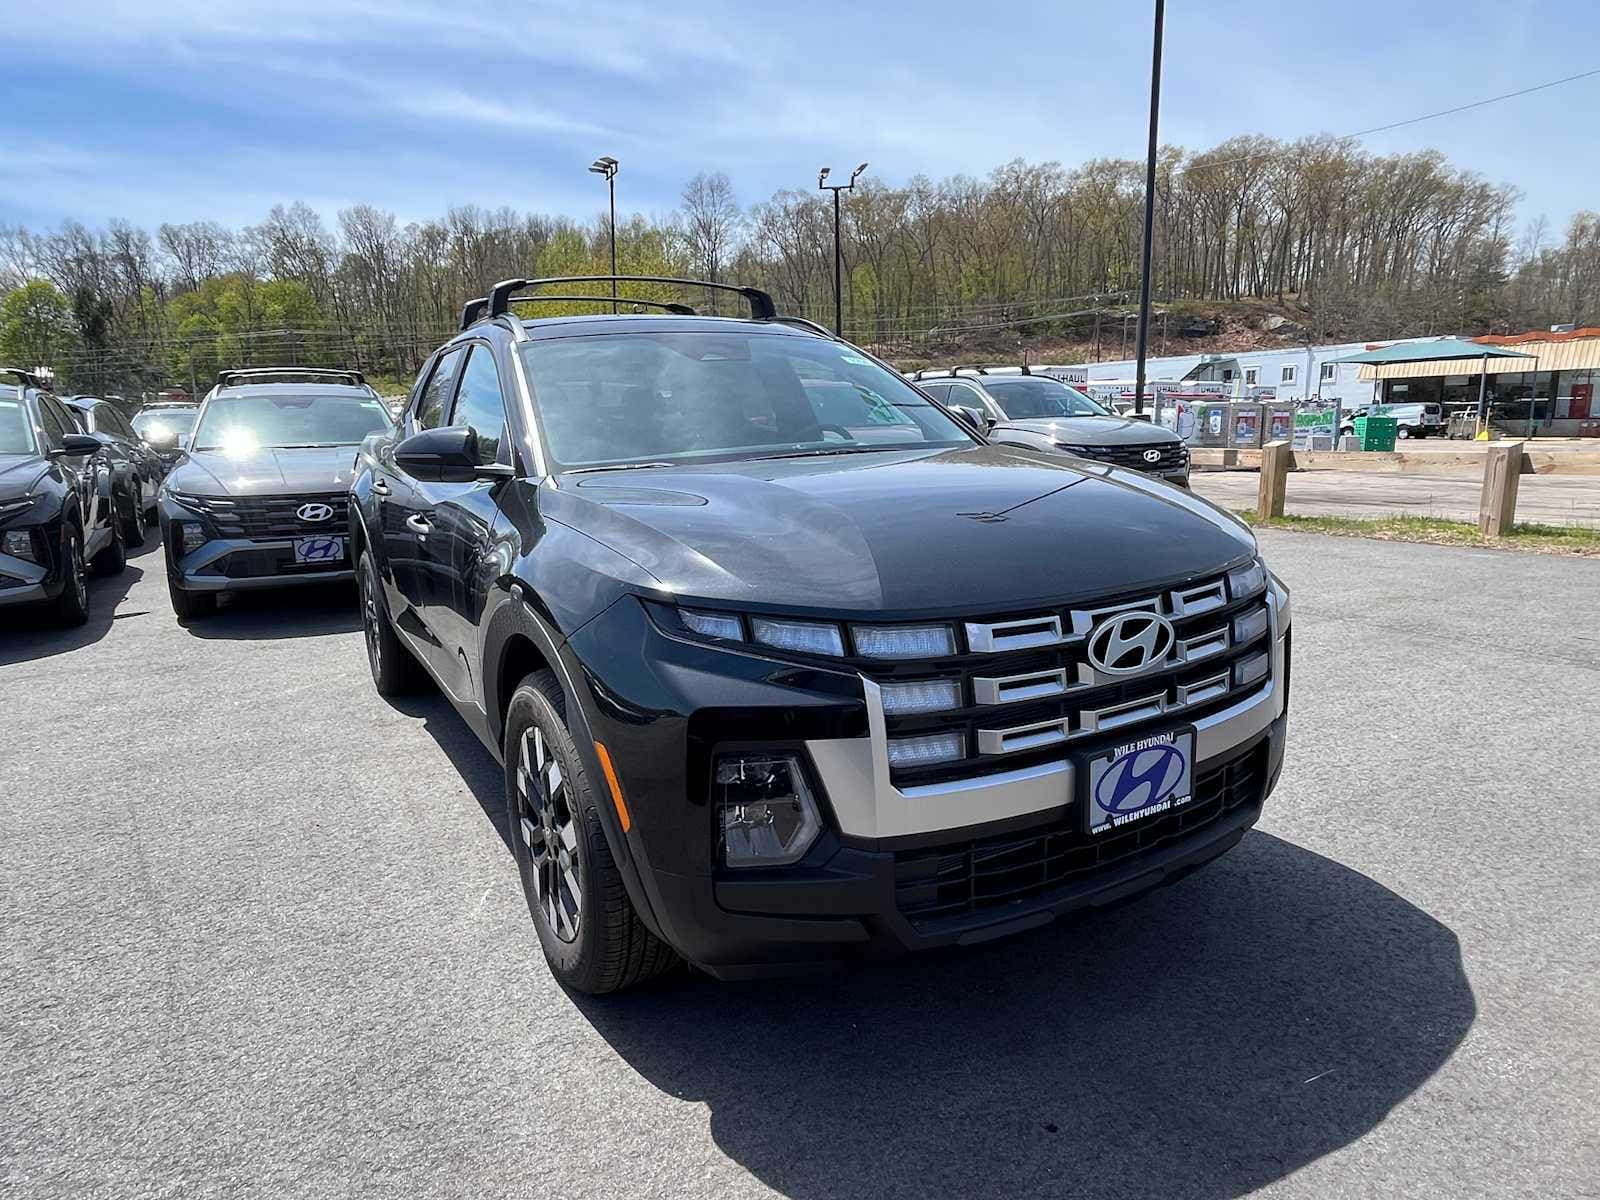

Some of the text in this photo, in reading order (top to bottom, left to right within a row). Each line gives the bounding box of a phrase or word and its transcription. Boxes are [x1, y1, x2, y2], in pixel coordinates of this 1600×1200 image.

[1114, 732, 1174, 758] WILE HYUNDAI
[1091, 795, 1192, 835] www. WILEHYUNDAI .com
